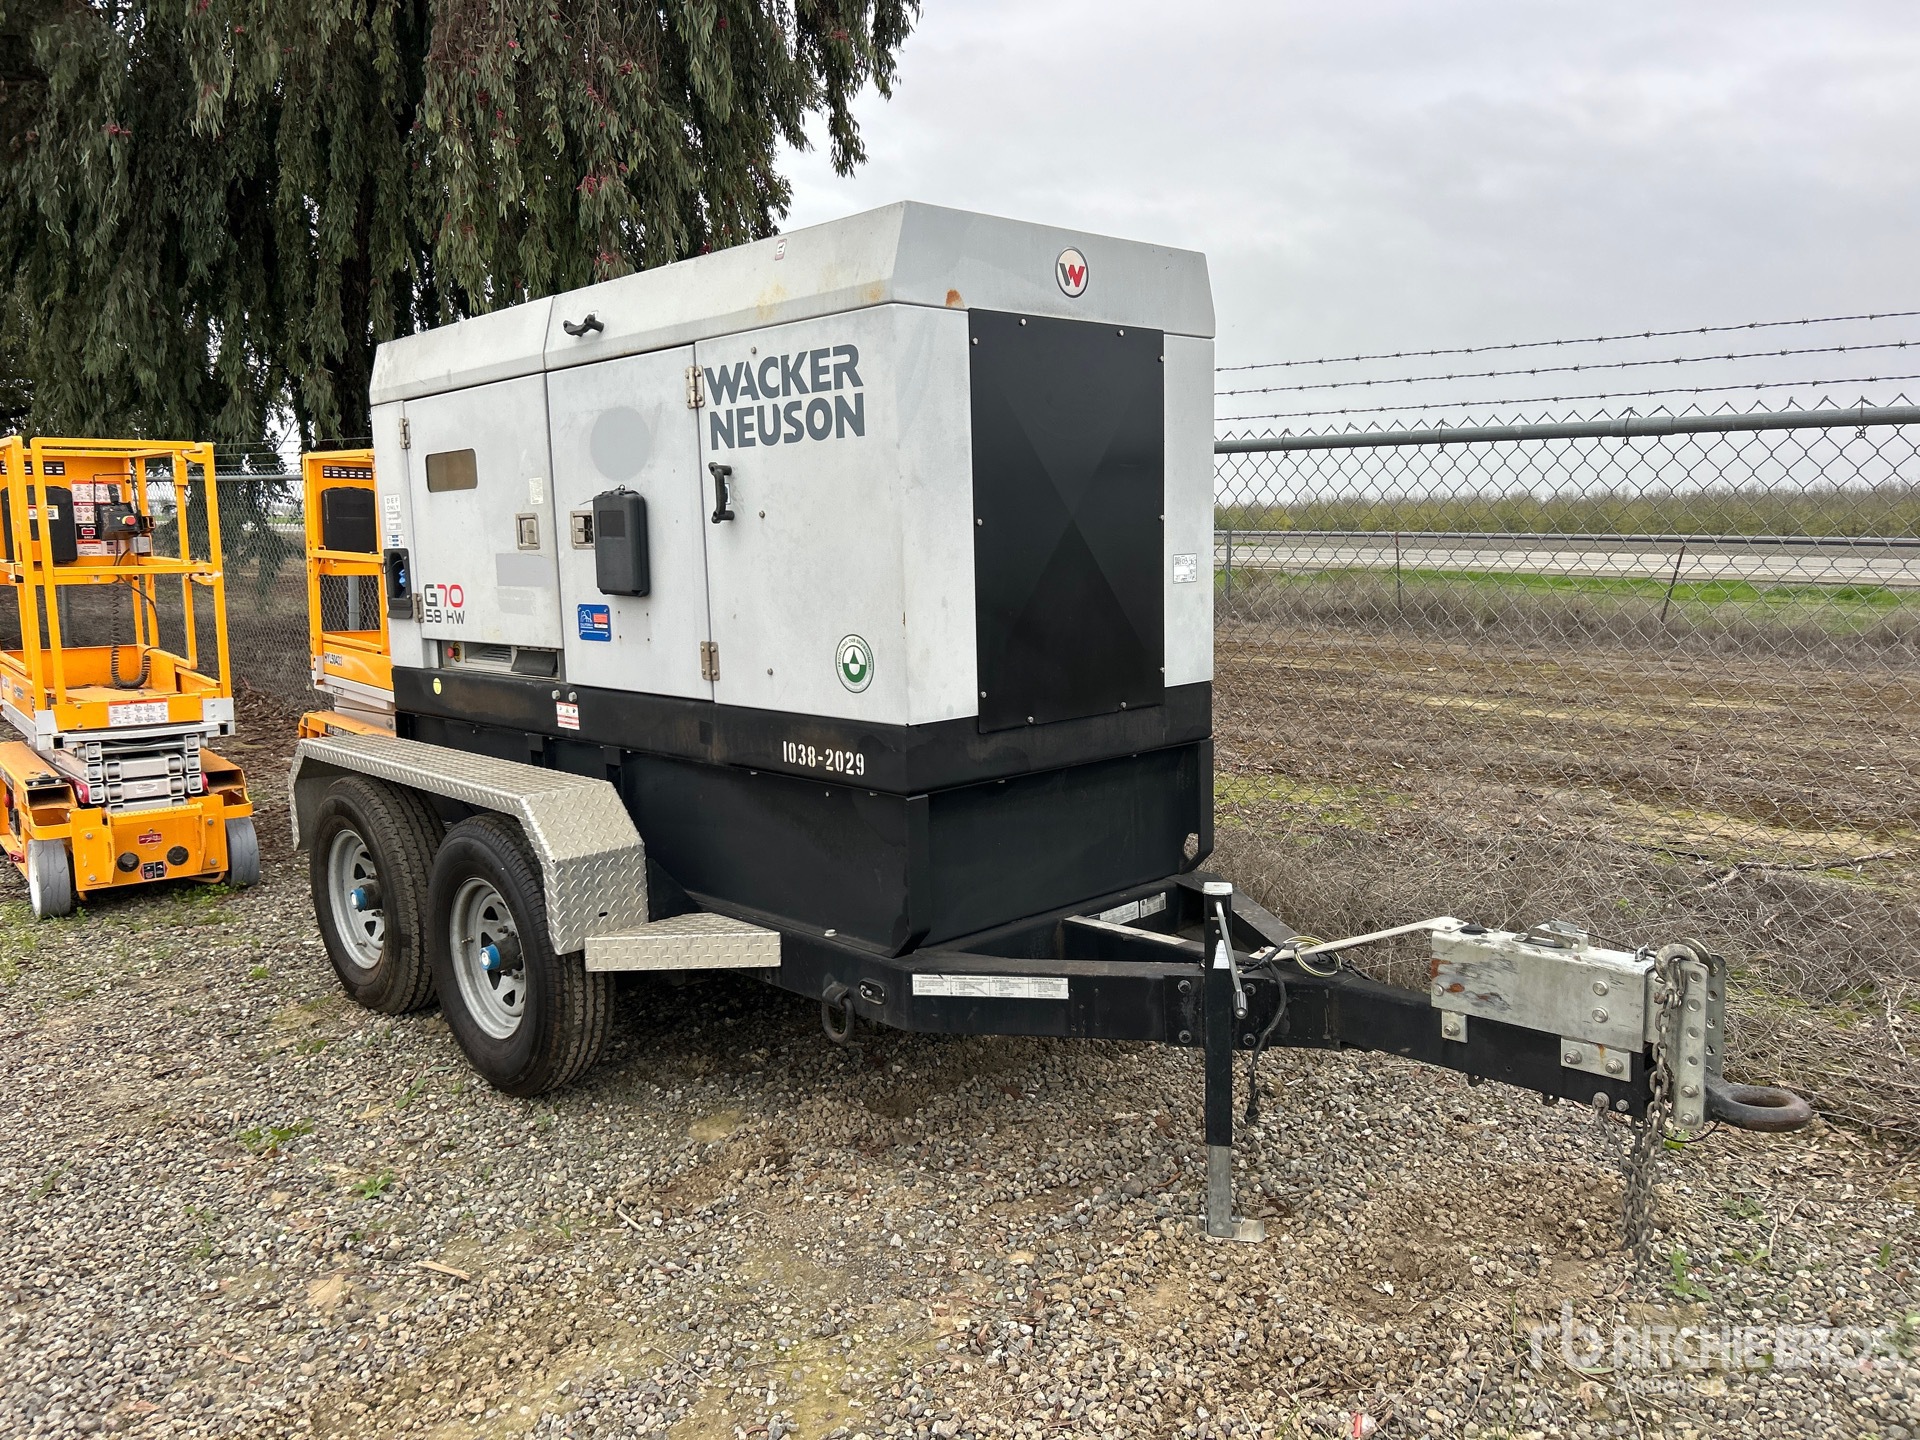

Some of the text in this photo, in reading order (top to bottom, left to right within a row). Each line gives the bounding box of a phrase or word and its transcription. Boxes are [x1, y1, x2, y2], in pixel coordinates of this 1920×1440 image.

[1058, 262, 1086, 288] W
[704, 344, 864, 405] WACKER
[710, 392, 866, 451] NEUSON
[424, 583, 464, 608] G70
[425, 608, 442, 624] 58
[782, 740, 866, 776] 1038-2029
